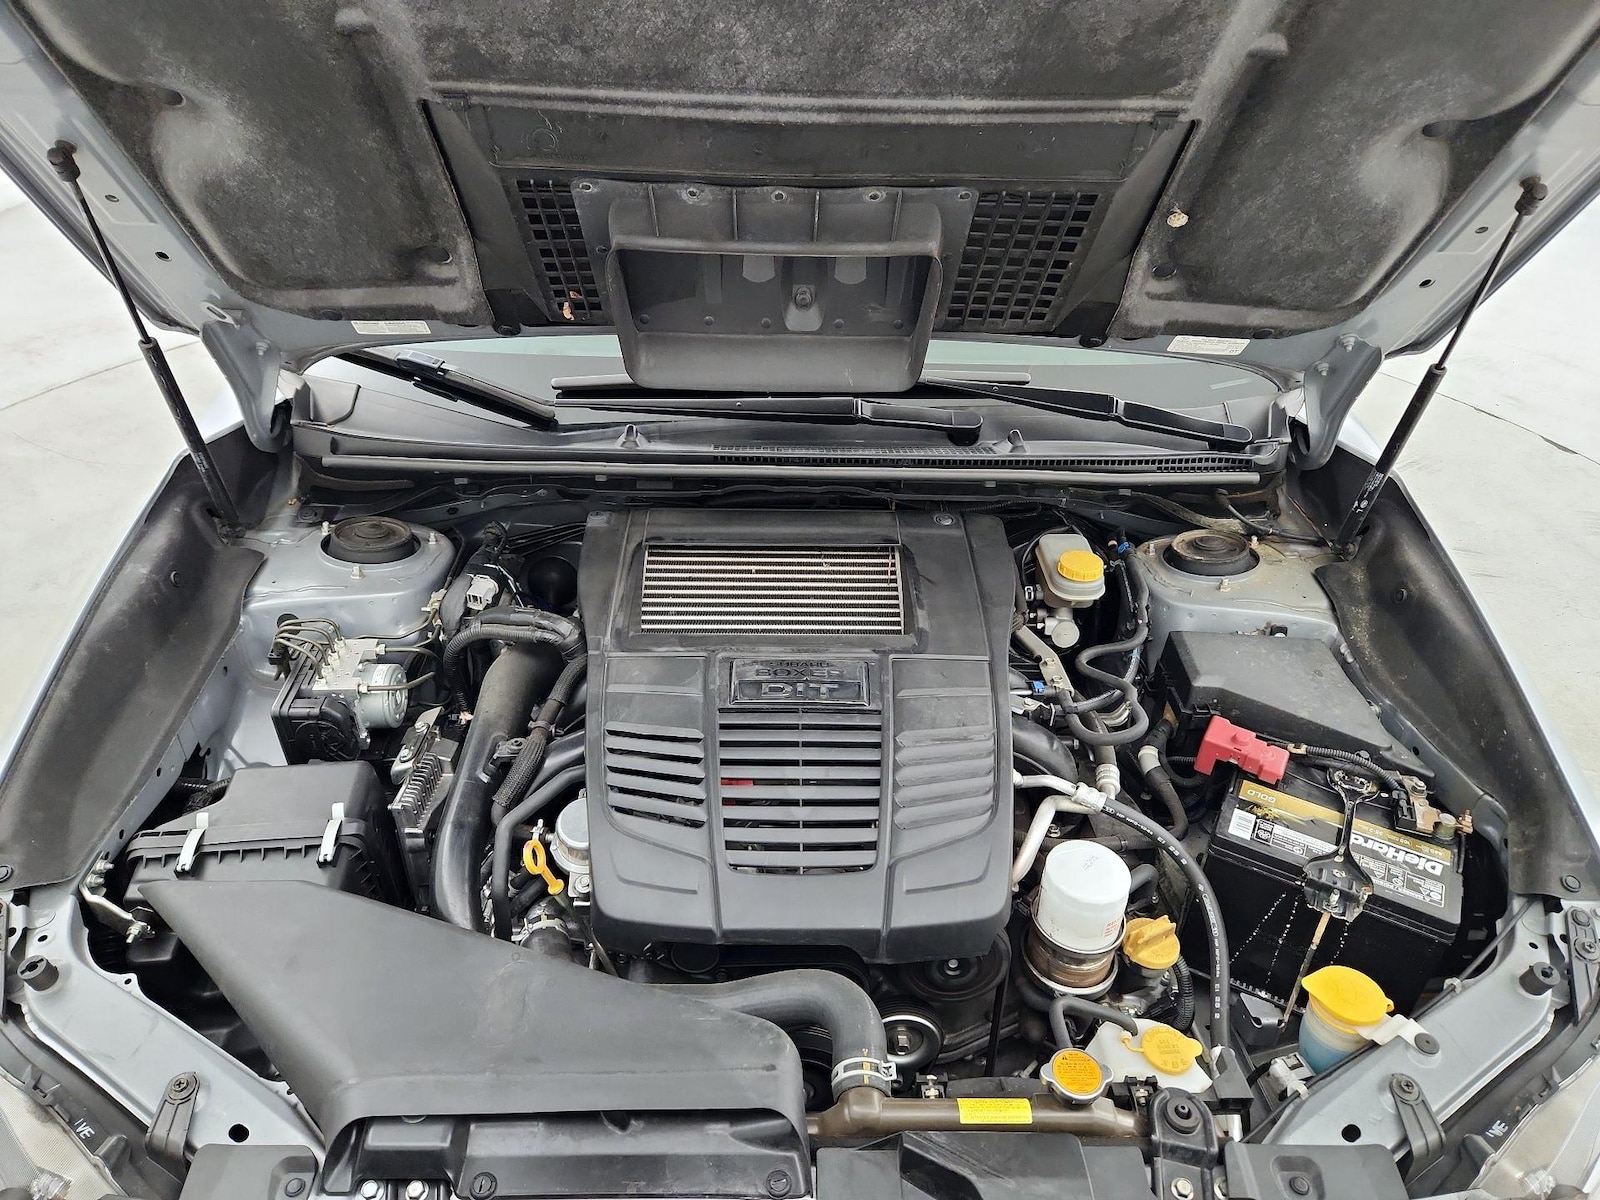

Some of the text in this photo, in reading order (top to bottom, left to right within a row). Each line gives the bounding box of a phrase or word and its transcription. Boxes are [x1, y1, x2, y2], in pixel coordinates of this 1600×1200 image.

[761, 682, 838, 698] DIT
[1246, 788, 1276, 803] GOLD
[1349, 834, 1443, 875] DieHard
